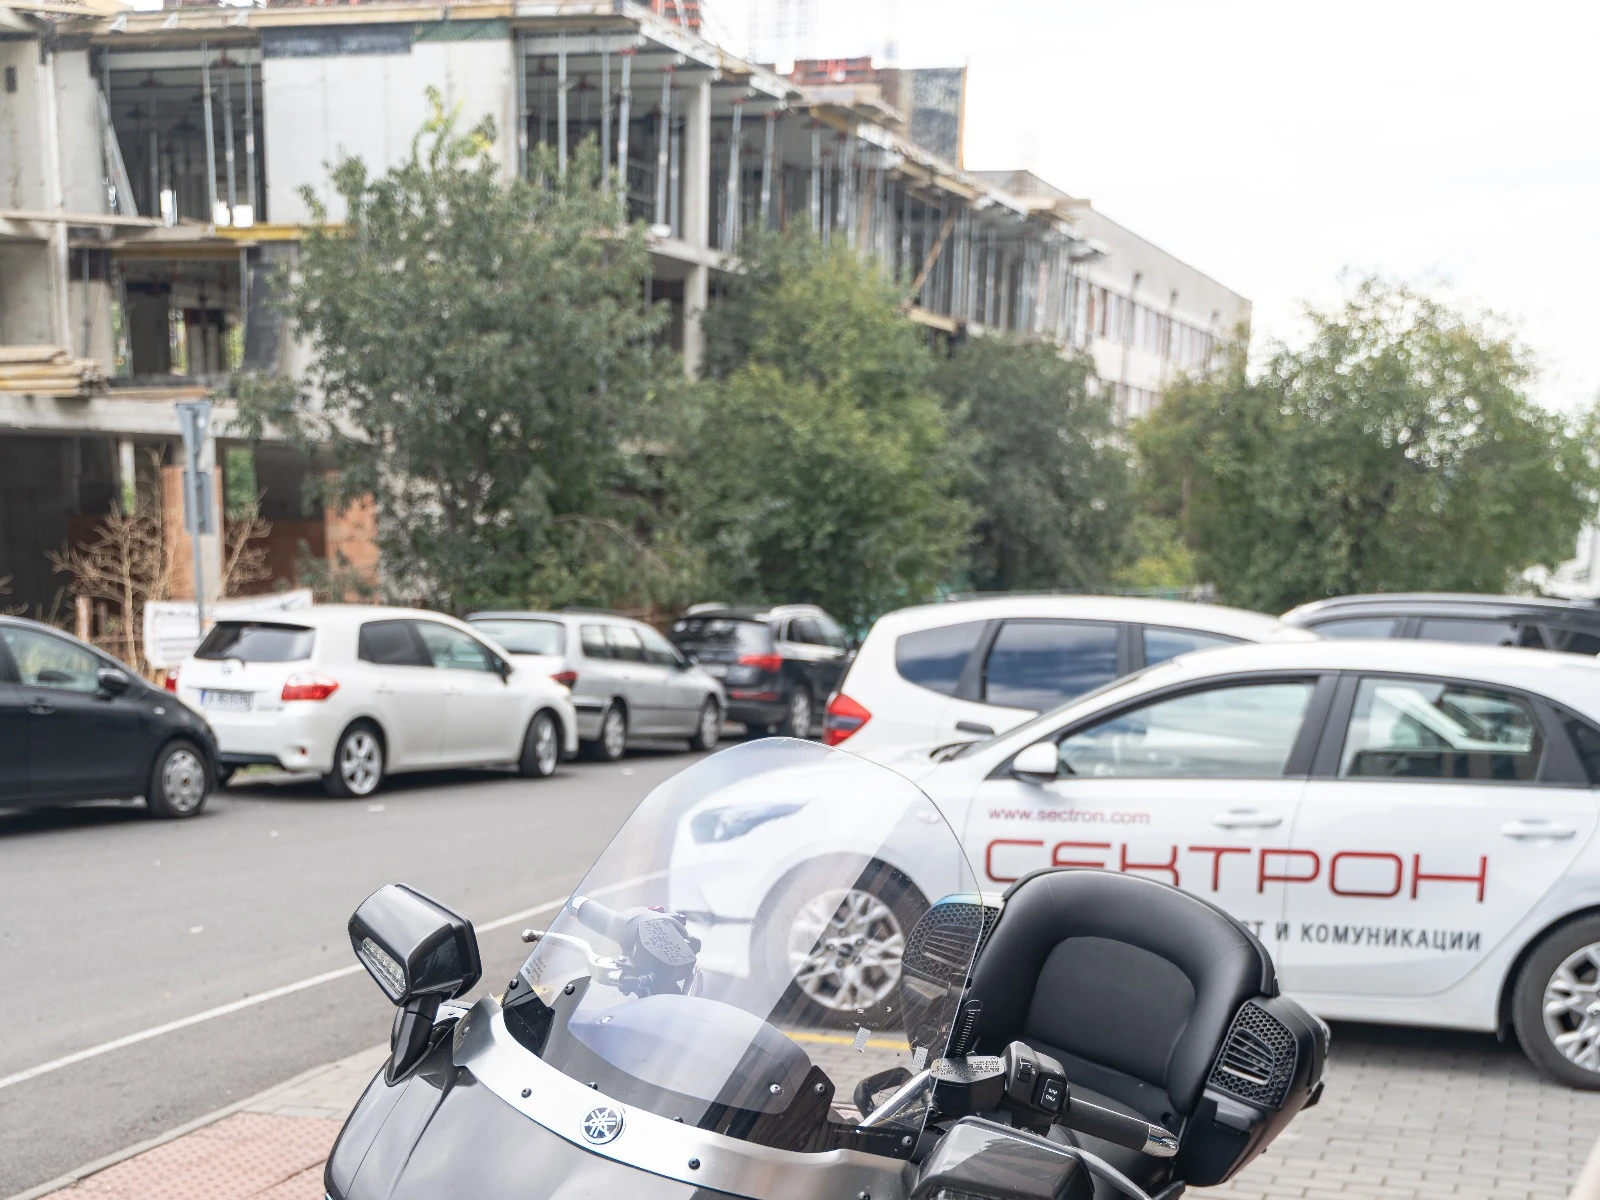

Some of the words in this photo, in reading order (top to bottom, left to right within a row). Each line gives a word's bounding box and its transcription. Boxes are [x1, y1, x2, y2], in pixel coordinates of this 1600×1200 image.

[988, 808, 1151, 825] www.sectron.com
[984, 838, 1489, 903] СЕКТРОН
[1275, 922, 1291, 942] И
[1300, 923, 1482, 951] КОМУНИКАЦИИ
